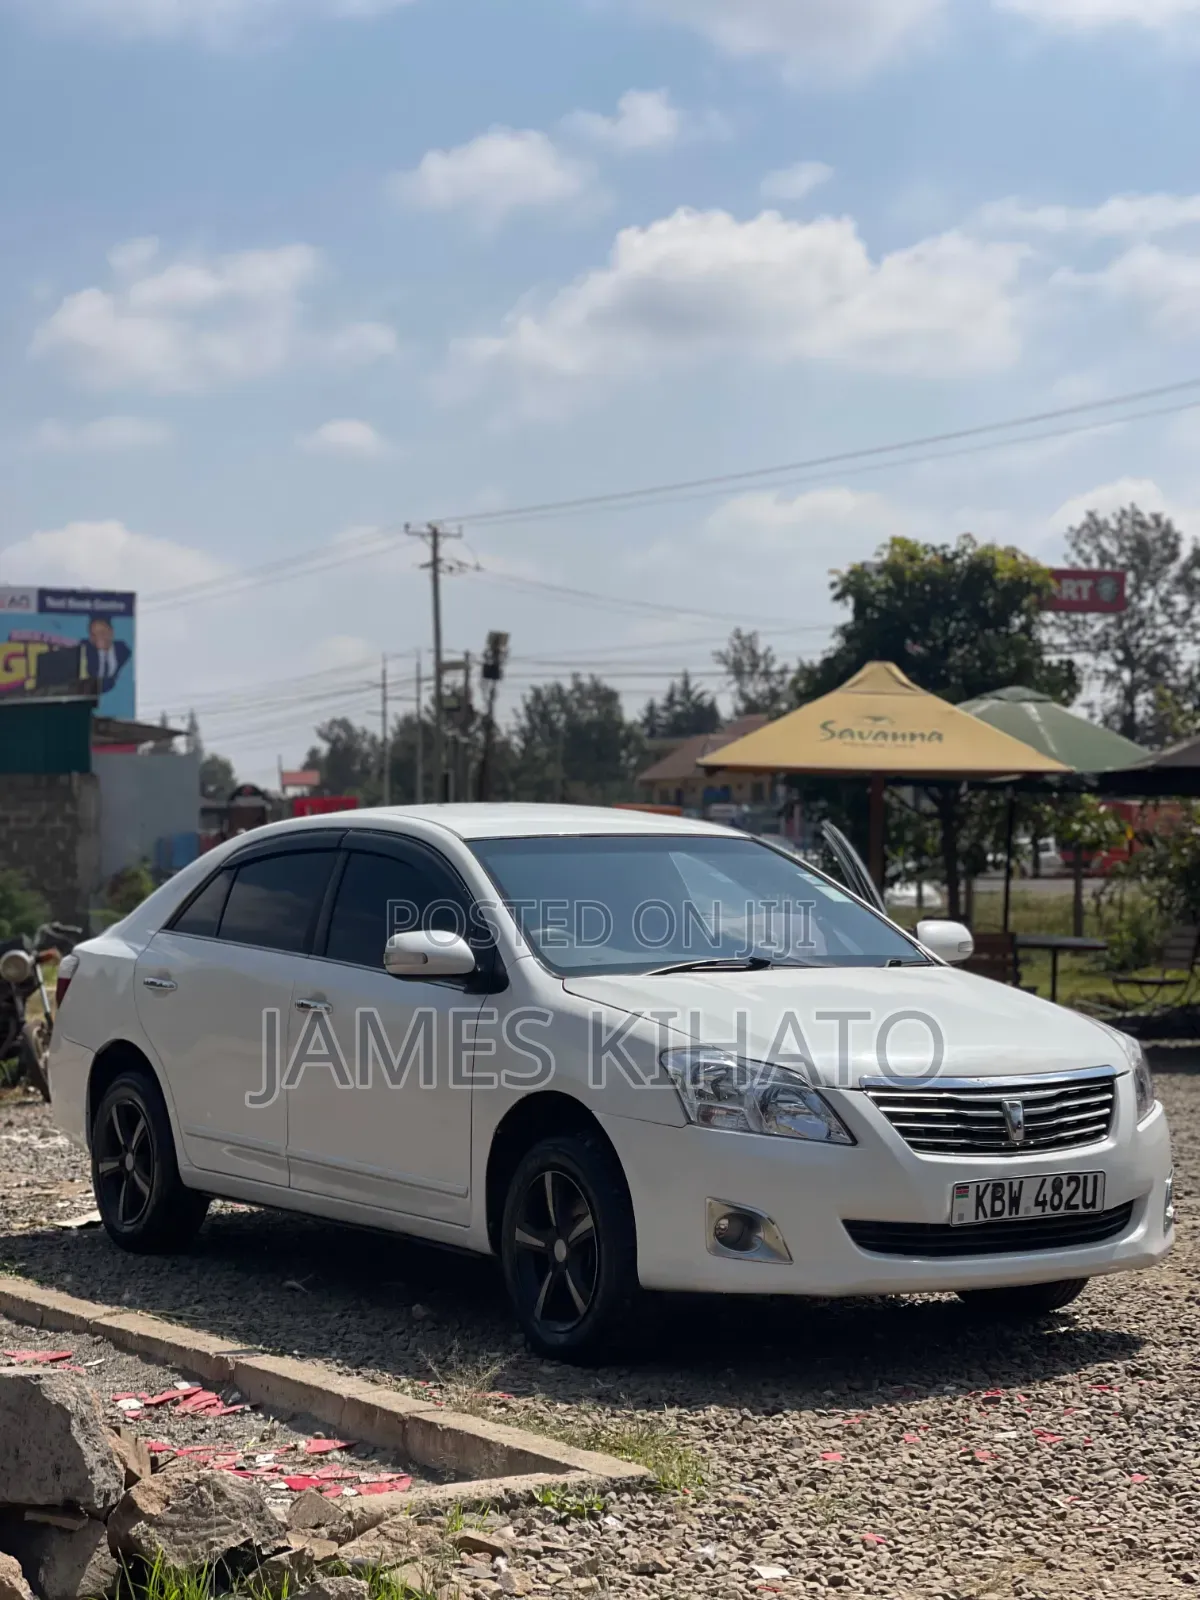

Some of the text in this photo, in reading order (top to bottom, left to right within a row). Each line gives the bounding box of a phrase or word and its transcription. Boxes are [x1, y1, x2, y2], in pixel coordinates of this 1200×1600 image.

[819, 720, 944, 744] Savanna
[974, 1174, 1099, 1221] KBW 482U
